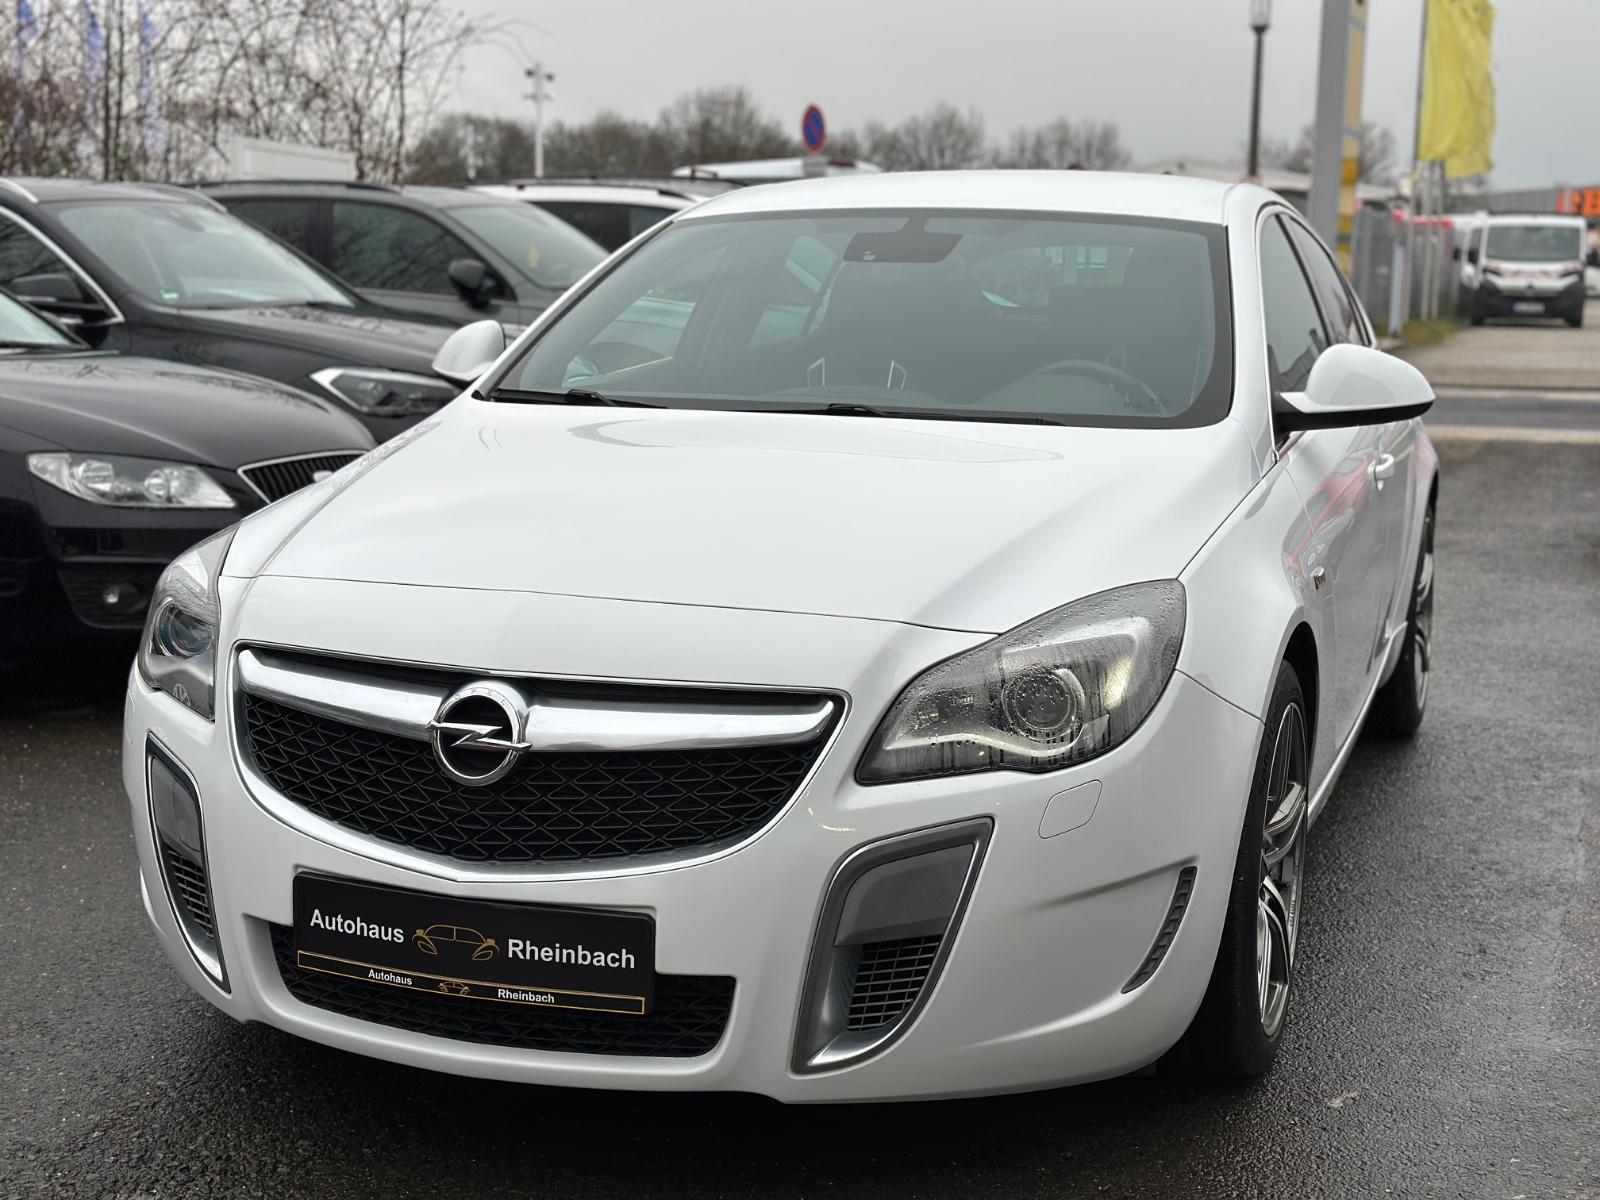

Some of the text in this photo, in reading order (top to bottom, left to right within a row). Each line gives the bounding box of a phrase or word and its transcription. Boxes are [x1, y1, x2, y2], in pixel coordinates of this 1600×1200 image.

[309, 908, 635, 969] Autohaus Rheinbach
[368, 968, 555, 1004] Autohaus Rheinbach
